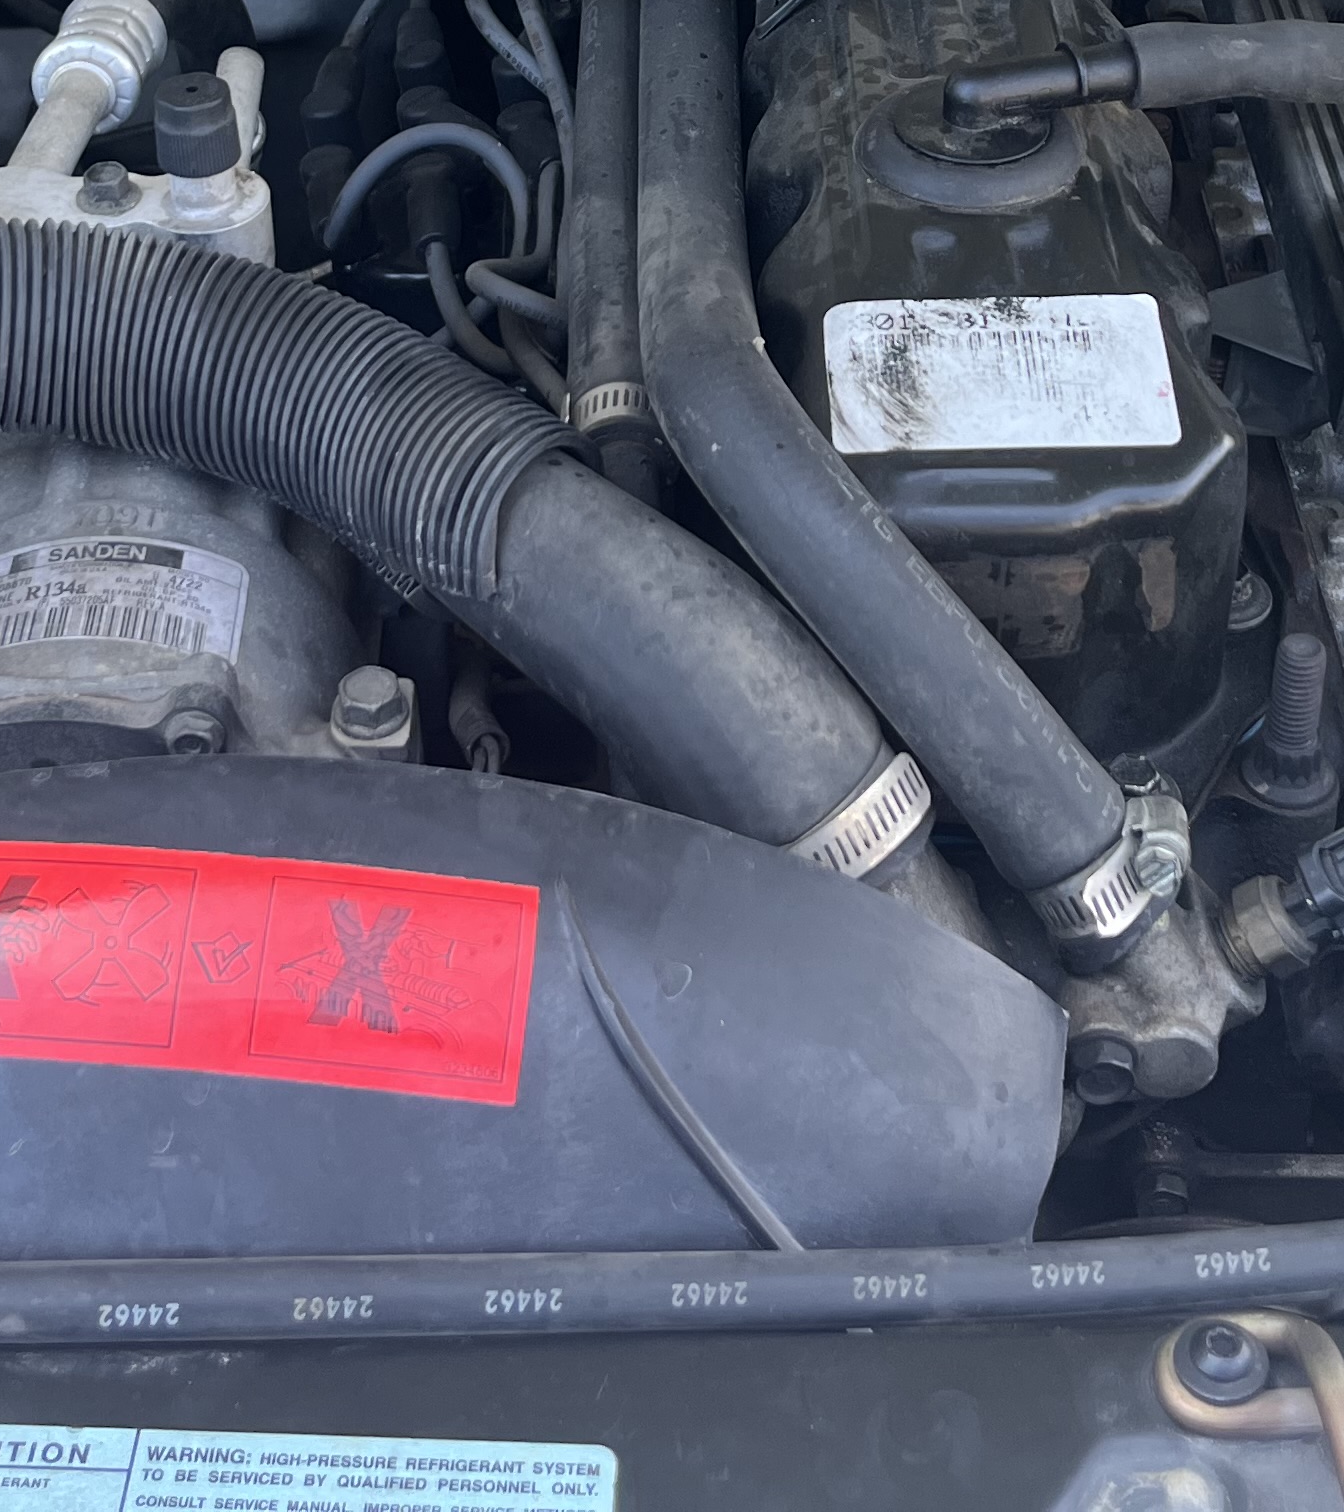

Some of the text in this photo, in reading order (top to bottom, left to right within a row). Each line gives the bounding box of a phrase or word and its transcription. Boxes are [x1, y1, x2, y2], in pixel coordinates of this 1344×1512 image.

[48, 541, 148, 563] SANDEN
[24, 579, 88, 602] R134a
[1030, 1259, 1106, 1289] 24462
[1195, 1247, 1272, 1279] 24462
[484, 1286, 564, 1315] 24462
[671, 1279, 749, 1308] 24462
[852, 1272, 927, 1300] 24462
[99, 1301, 181, 1328] 24462
[293, 1293, 374, 1322] 24462
[147, 1444, 601, 1477] WARNING: HIGH-PRESSURE REFRIGERANT SYSTEM
[142, 1467, 600, 1497] TO BE SERVICED BY QUALIFIED PERSONNEL ONLY.
[134, 1494, 208, 1508] CONSULT
[214, 1496, 279, 1511] SERVICE
